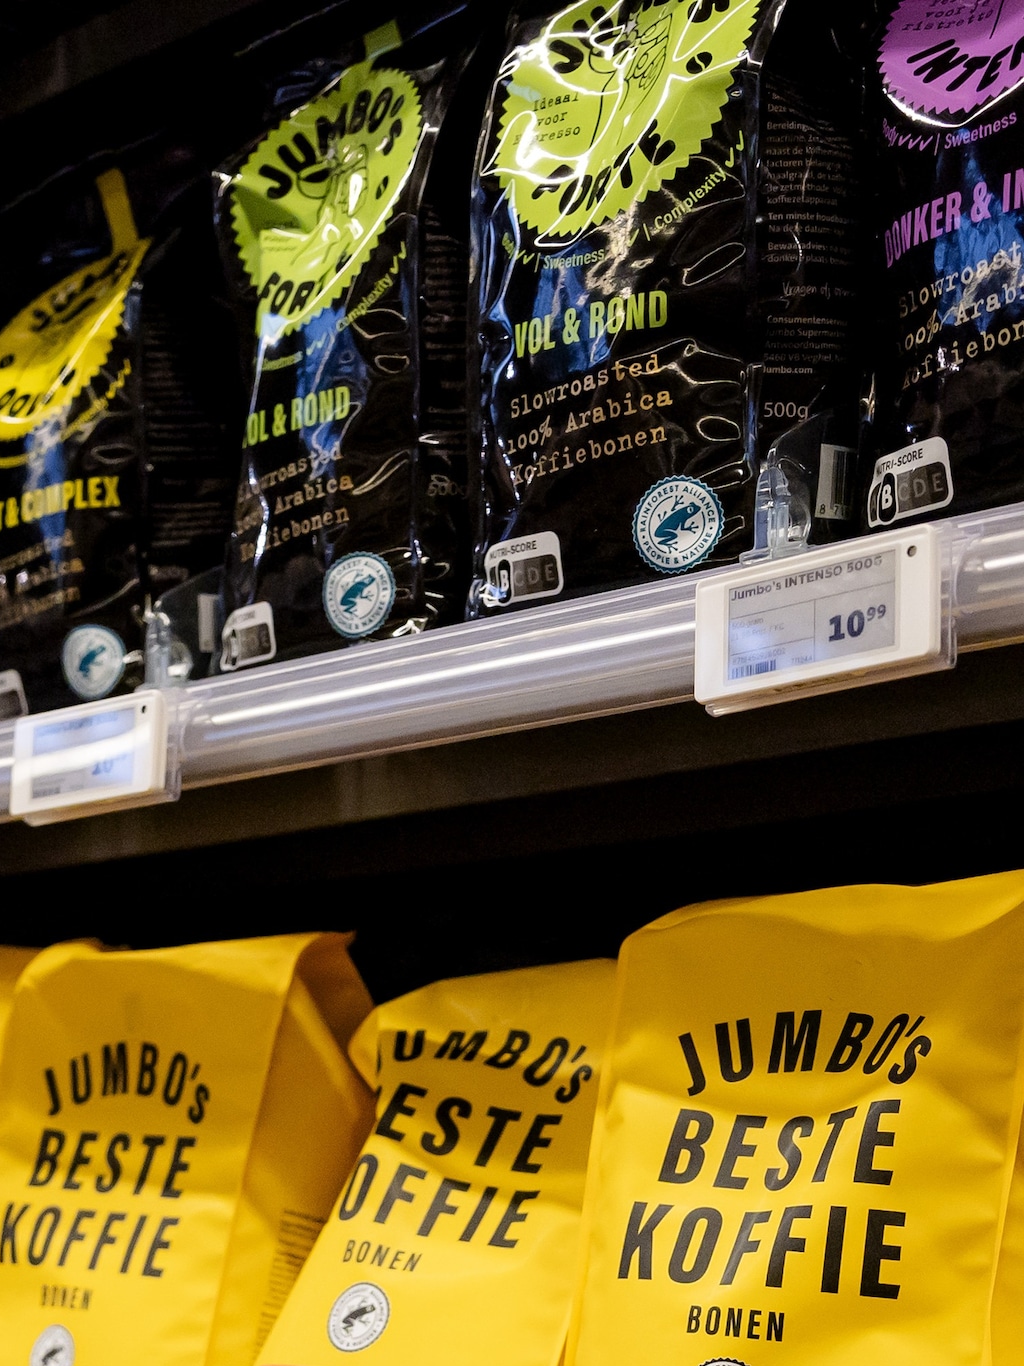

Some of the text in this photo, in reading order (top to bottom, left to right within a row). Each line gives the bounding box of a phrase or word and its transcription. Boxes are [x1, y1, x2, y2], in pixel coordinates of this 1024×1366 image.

[533, 91, 580, 112] Ideaal
[944, 112, 1017, 149] Sweetness
[543, 168, 726, 270] Sweetness Complexity
[884, 191, 962, 269] DONKER
[970, 181, 994, 223] &
[515, 290, 668, 358] VOL & ROND
[273, 403, 287, 437] &
[291, 386, 351, 430] ROND
[510, 354, 661, 418] Slowroasted
[763, 401, 809, 423] 500g
[507, 390, 673, 455] 100% Arabica
[512, 426, 667, 486] Koffiebonen
[21, 476, 120, 523] COMPLEX
[274, 475, 354, 514] Arabica
[640, 485, 678, 532] RAINFOREST
[683, 486, 716, 523] ALLIANCE
[643, 541, 670, 565] PEOPLE
[682, 533, 712, 561] NATURE
[731, 581, 782, 601] Jumbo's
[784, 566, 842, 589] INTENSO
[376, 1029, 592, 1103] UMBO's
[375, 1083, 563, 1173] ESTE
[658, 1100, 901, 1190] BESTE
[29, 1128, 197, 1198] BESTE
[338, 1153, 540, 1248] OFFIE
[0, 1203, 179, 1277] KOFFIE
[343, 1239, 423, 1272] BONEN
[618, 1202, 906, 1300] KOFFIE
[686, 1305, 785, 1342] BONEN
